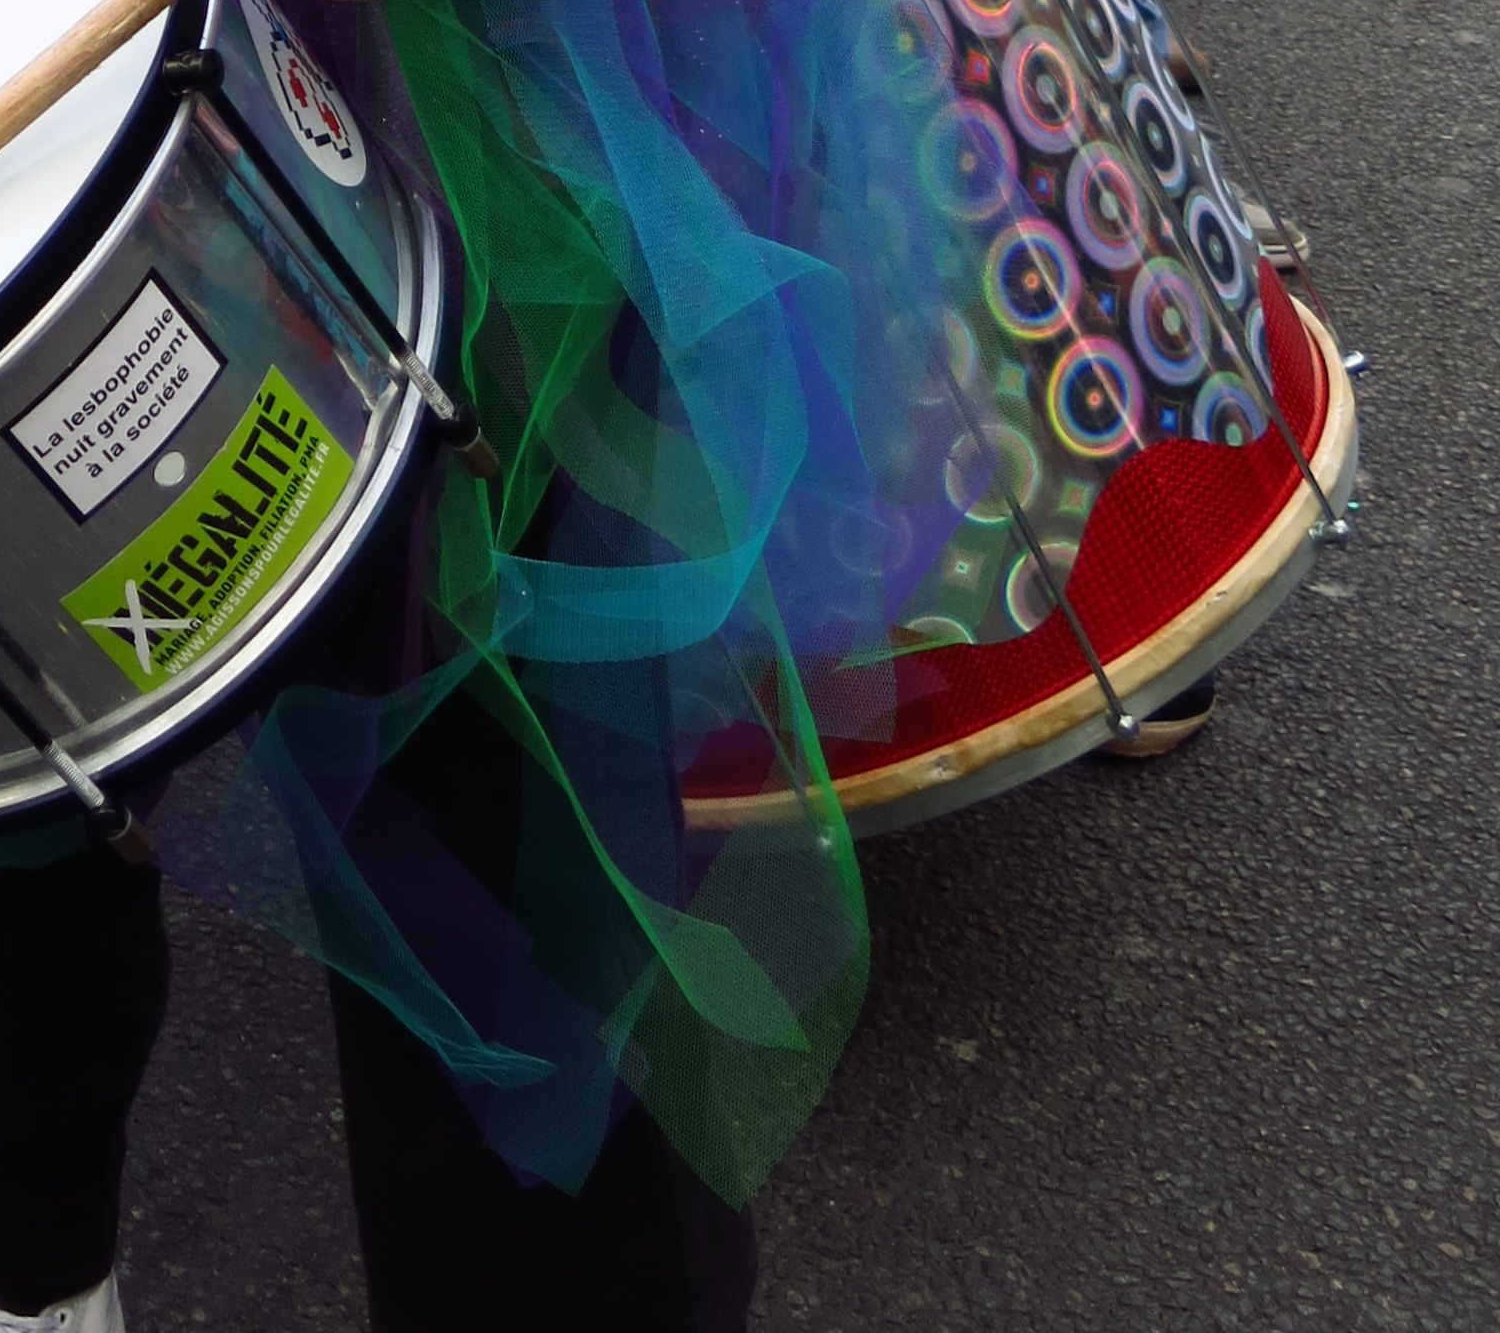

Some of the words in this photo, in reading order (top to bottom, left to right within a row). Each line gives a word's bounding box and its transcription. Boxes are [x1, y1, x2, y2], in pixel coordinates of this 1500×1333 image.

[32, 431, 64, 459] La
[62, 307, 174, 432] lesbophobie
[53, 432, 96, 476] nuit
[97, 326, 189, 439] gravement
[86, 461, 104, 479] à
[102, 444, 126, 463] la
[126, 364, 190, 442] société
[165, 441, 331, 675] WWW.AGISSONSPOURLEGALITE.FR
[208, 543, 265, 612] ADOPTION,
[259, 473, 307, 542] FILIATION,
[299, 434, 320, 471] PMA
